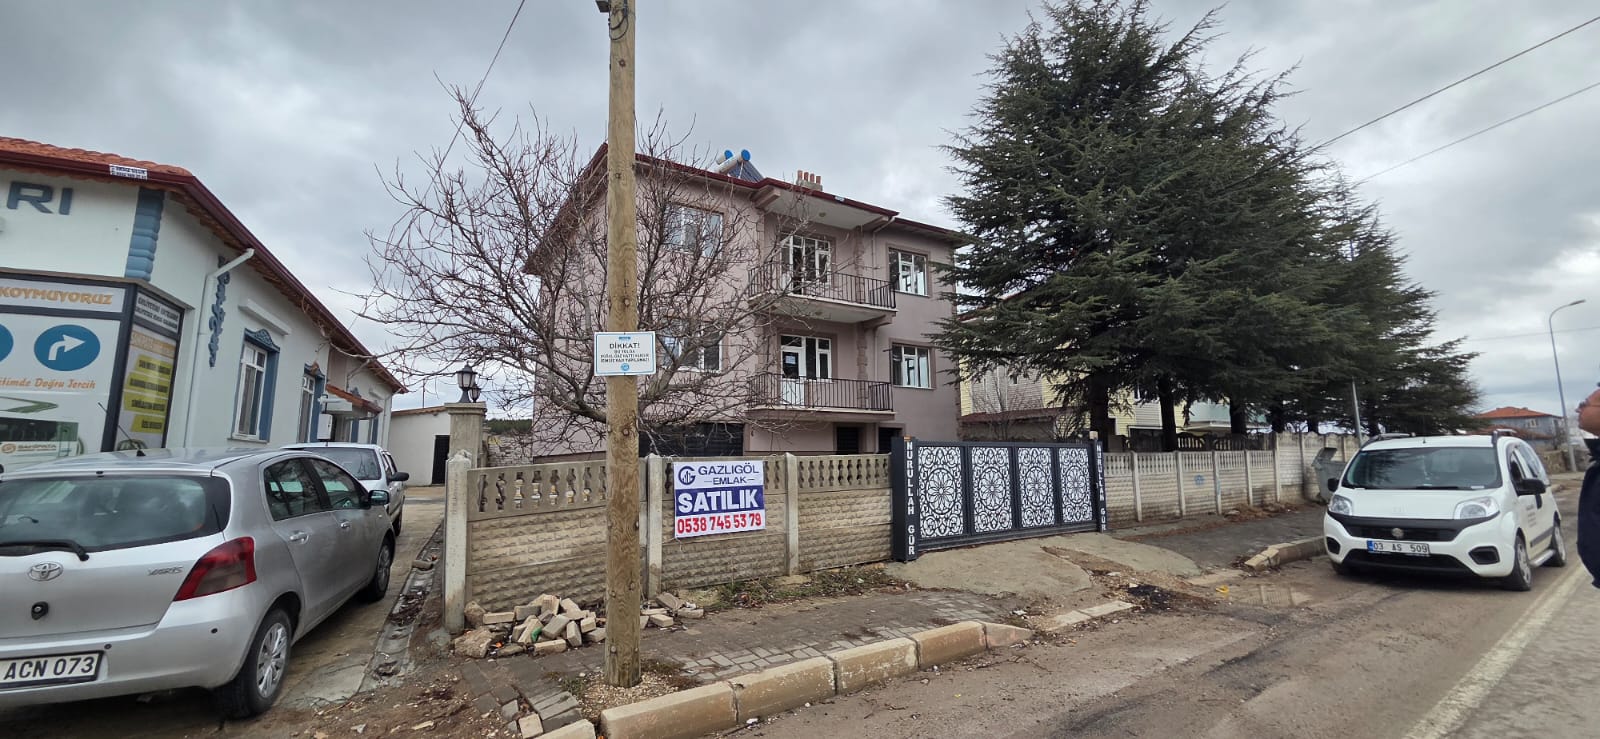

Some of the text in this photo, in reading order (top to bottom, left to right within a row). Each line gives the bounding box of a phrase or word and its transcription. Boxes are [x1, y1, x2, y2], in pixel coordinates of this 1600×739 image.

[698, 462, 759, 475] GAZLIGÖL
[906, 441, 915, 515] NURULLAH
[713, 476, 747, 485] EMLAK
[678, 489, 759, 513] SATILIK
[677, 512, 762, 534] 0538 745 53 79
[1374, 542, 1428, 553] 03 AS 509
[3, 656, 95, 680] ACN 073
